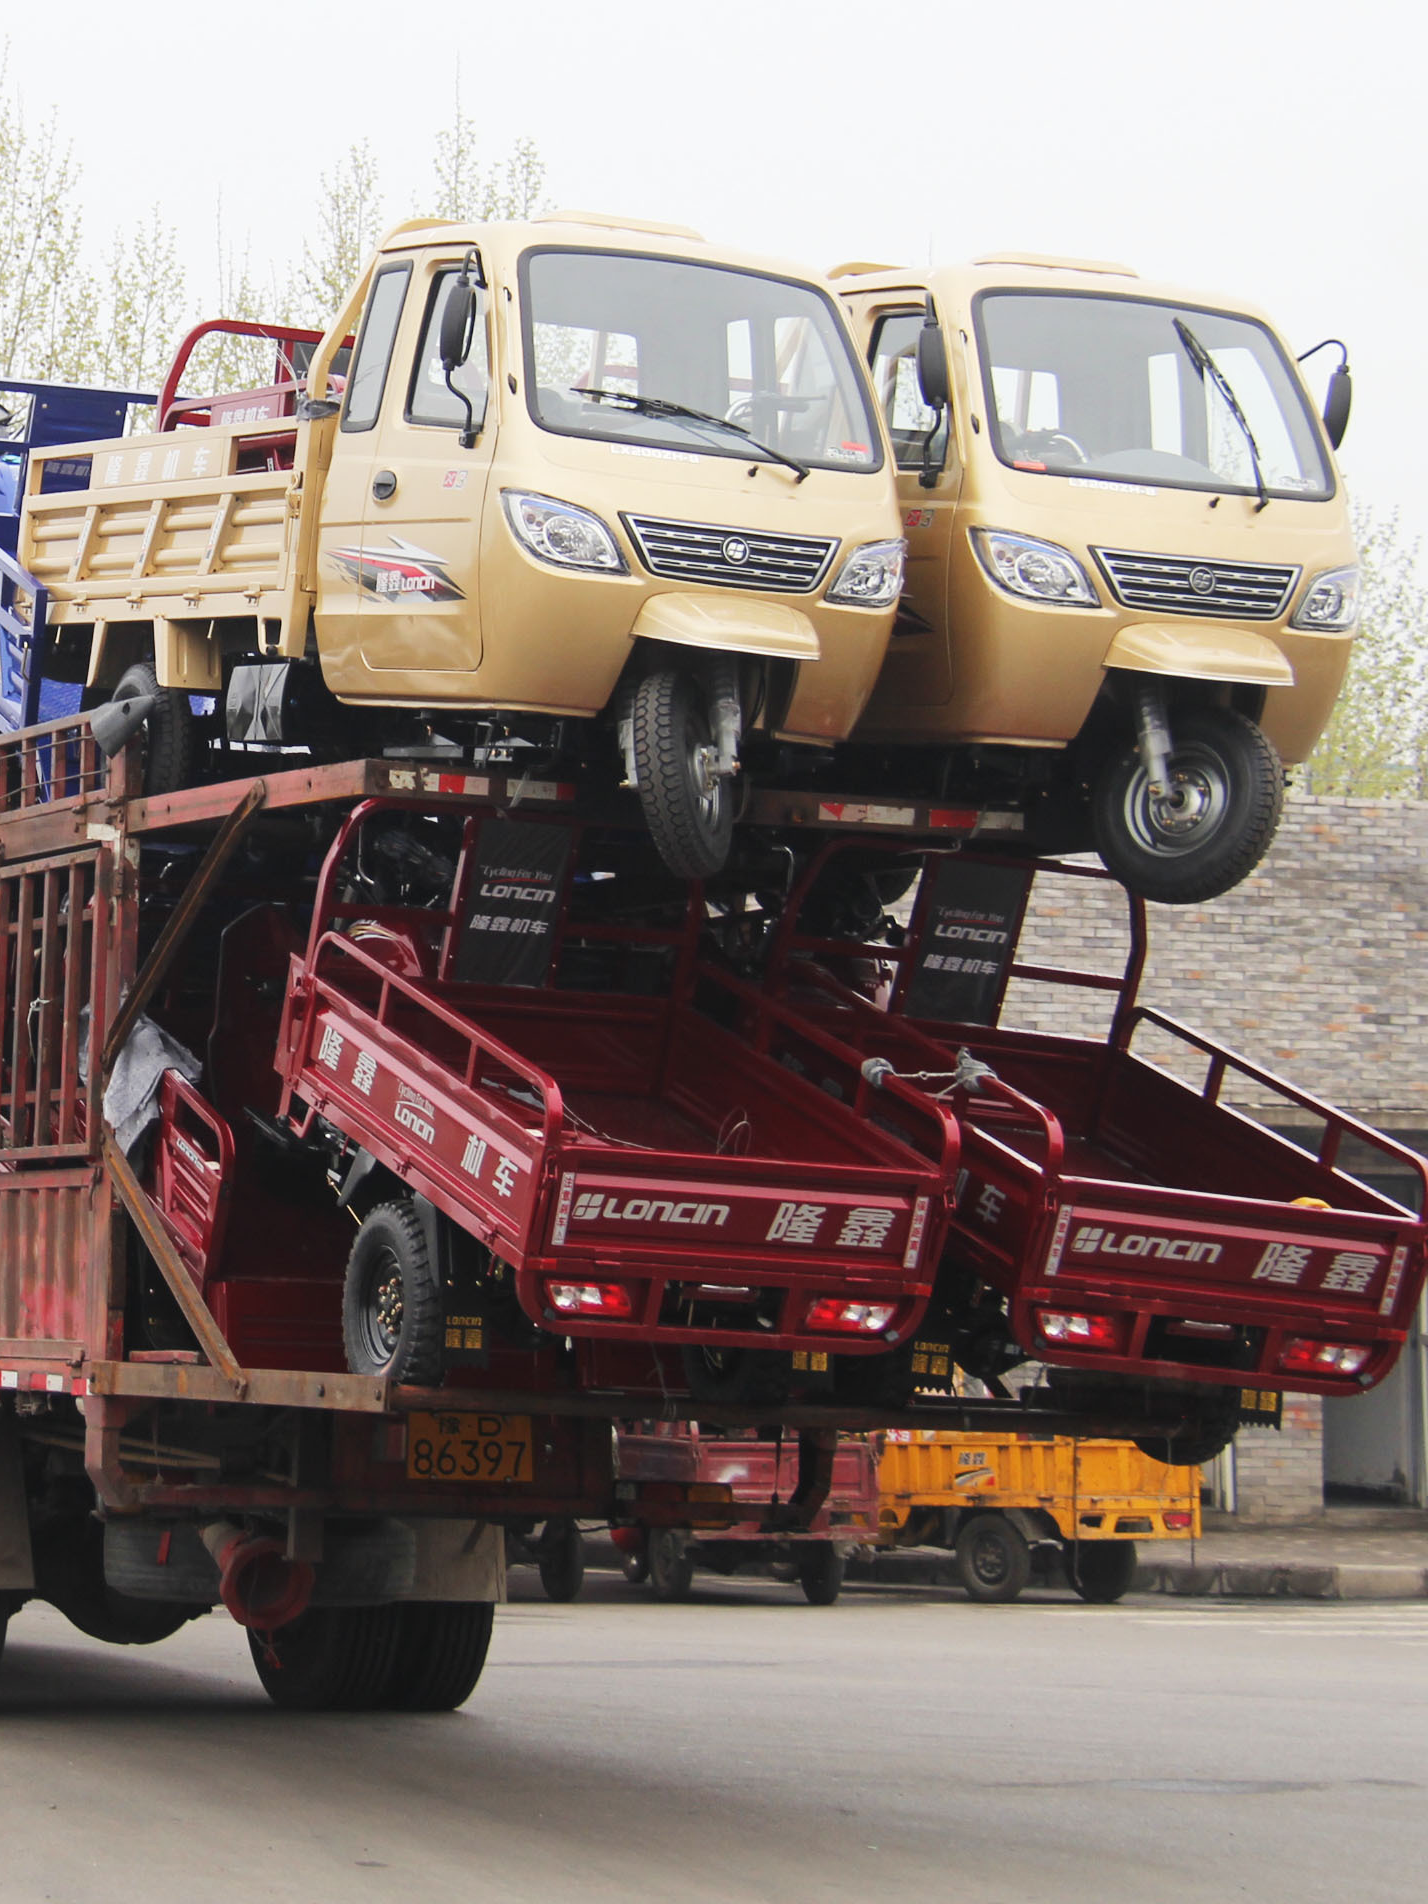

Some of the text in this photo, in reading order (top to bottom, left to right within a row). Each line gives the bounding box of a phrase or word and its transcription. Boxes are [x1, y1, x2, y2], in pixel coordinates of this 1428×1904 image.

[765, 1201, 896, 1248] 隆鑫
[1251, 1242, 1381, 1294] 隆鑫
[414, 1438, 526, 1478] 86397
